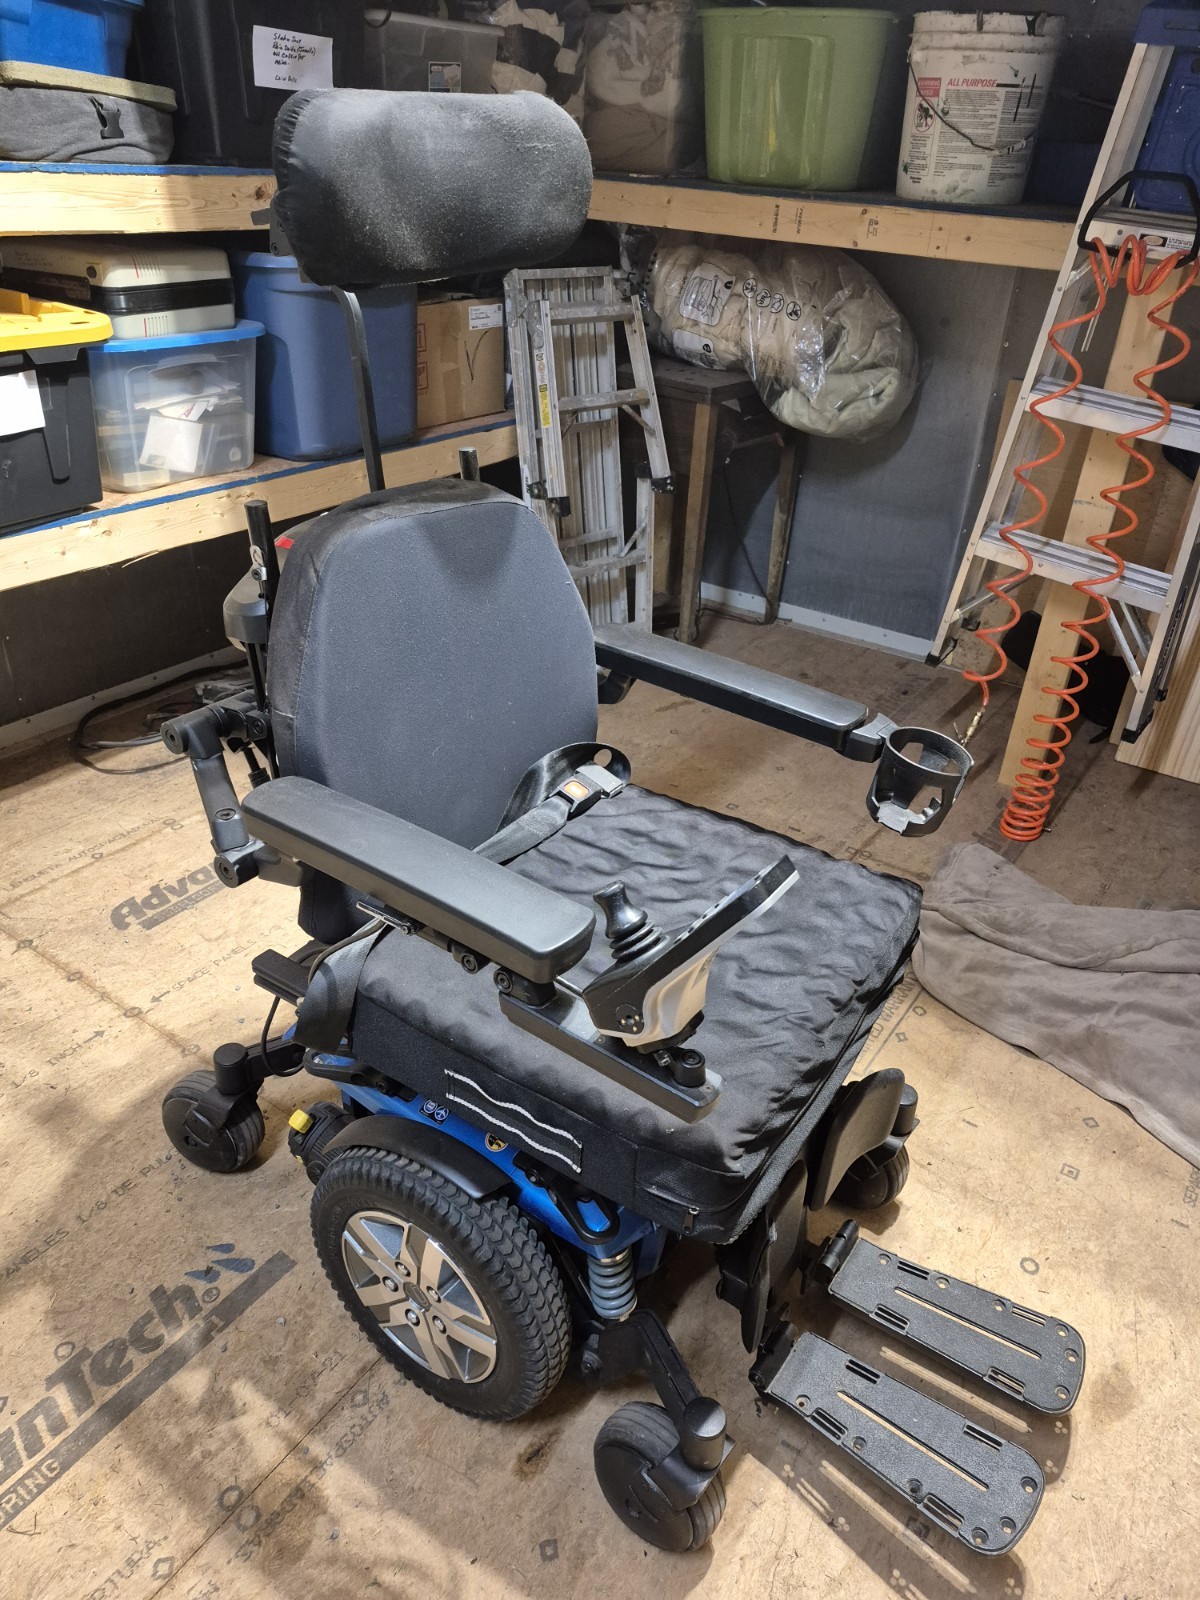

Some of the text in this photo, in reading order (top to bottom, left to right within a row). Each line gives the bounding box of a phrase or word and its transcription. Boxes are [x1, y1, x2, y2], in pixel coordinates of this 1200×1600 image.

[947, 78, 997, 88] ALL PURPOSE
[110, 862, 217, 931] Adva
[48, 1042, 82, 1067] INCH
[111, 1178, 137, 1198] DE
[0, 1458, 61, 1523] RING
